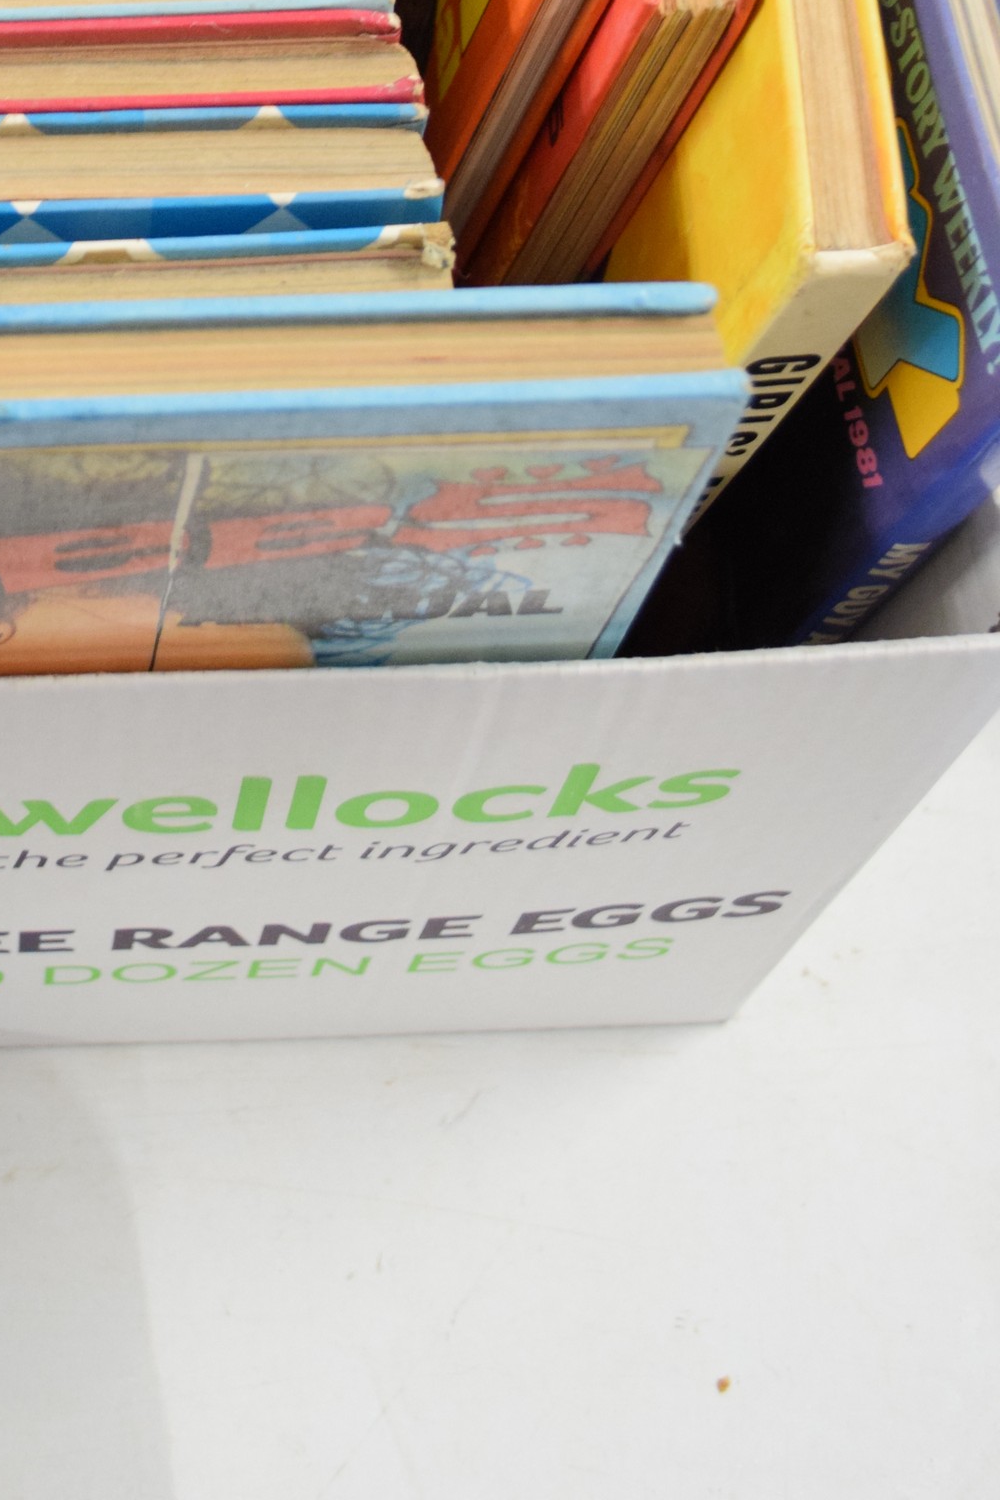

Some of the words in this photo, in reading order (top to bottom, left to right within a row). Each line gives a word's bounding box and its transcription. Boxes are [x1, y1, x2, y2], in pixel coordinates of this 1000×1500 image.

[844, 406, 883, 488] 1981
[866, 542, 932, 579] MY
[822, 584, 890, 627] GUY
[105, 843, 343, 872] perfect
[360, 821, 691, 864] ingredient
[111, 914, 483, 951] RANGE
[509, 890, 791, 935] EGGS
[43, 956, 373, 987] DOZEN
[406, 937, 675, 974] EGGS
